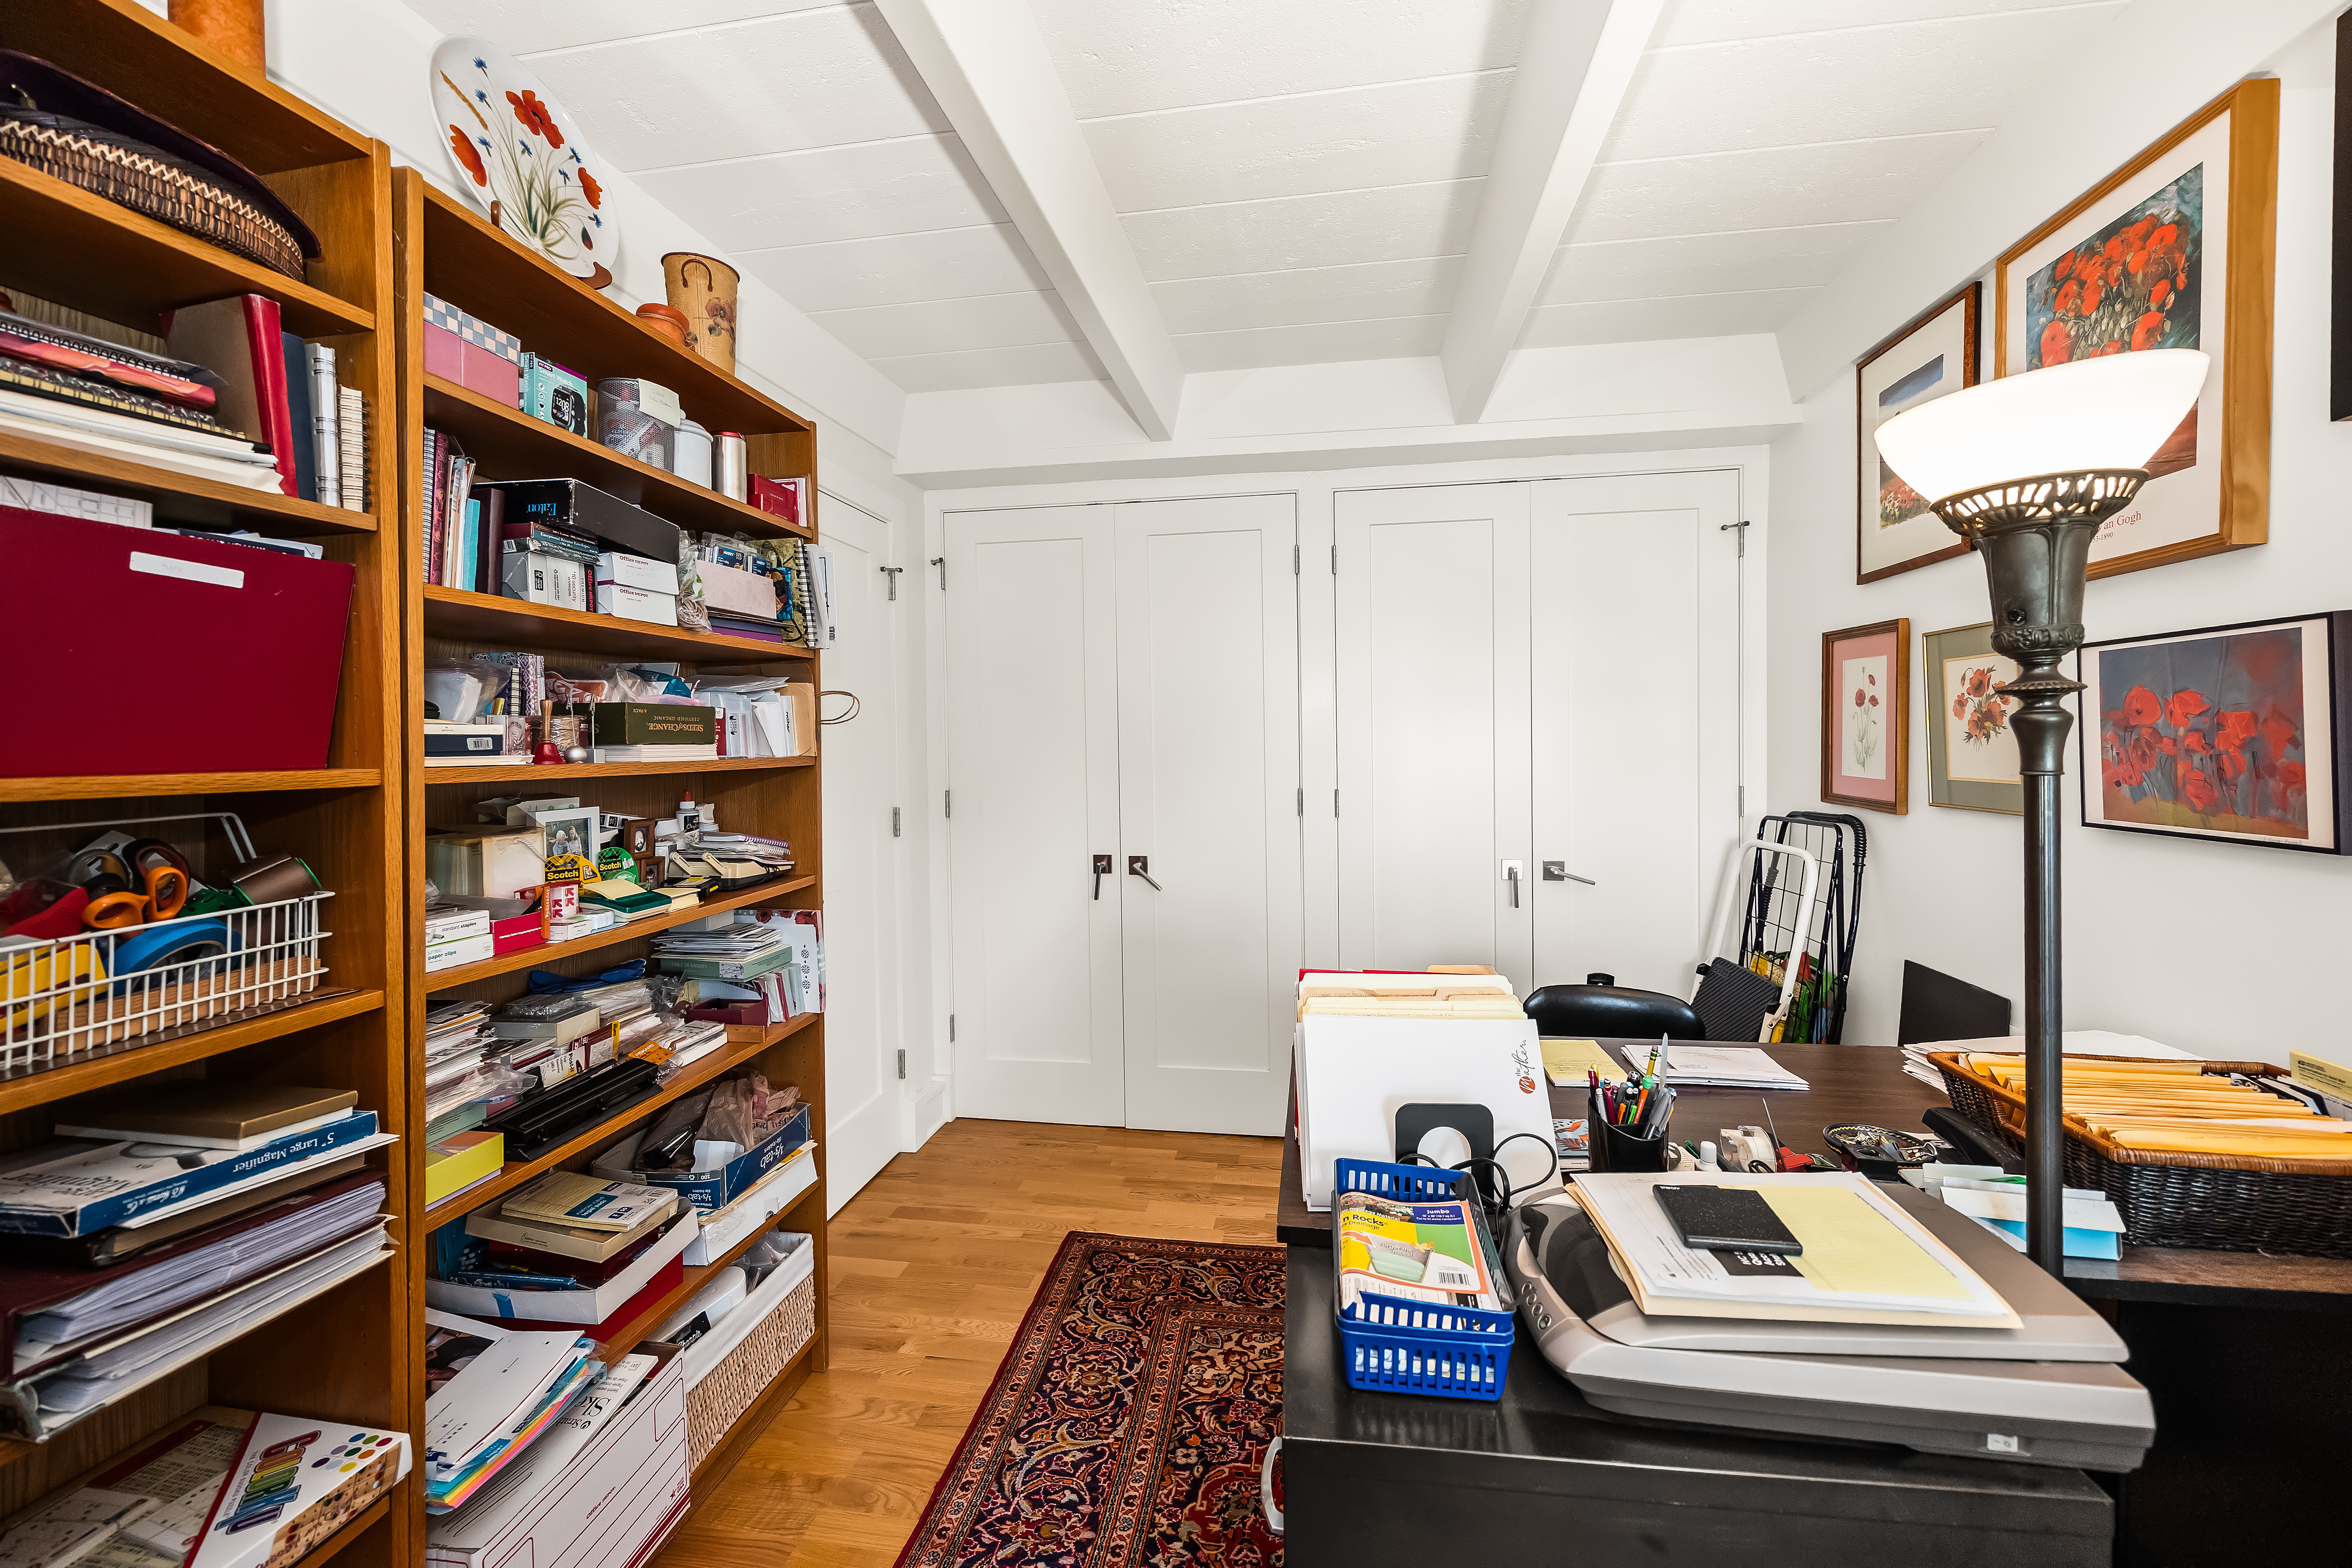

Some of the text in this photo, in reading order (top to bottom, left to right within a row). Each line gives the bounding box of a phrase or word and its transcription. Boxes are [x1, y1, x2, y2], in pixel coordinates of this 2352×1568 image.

[539, 367, 573, 387] Smart Watch
[528, 503, 557, 516] Eaton
[2117, 511, 2142, 526] Gogh
[540, 532, 560, 541] Exceptional
[600, 861, 622, 871] Scotch
[547, 870, 579, 880] Scotch
[634, 1043, 655, 1057] FISKARS
[289, 1138, 318, 1153] Large
[764, 1141, 776, 1153] folders
[233, 1148, 287, 1173] Magnifier
[581, 1200, 607, 1216] legal pads
[1353, 1214, 1384, 1226] Rocks
[1376, 1212, 1400, 1221] Material
[1349, 1221, 1380, 1230] Drainage
[1379, 1242, 1402, 1252] Forget
[214, 1430, 322, 1535] COLORKU
[586, 1501, 602, 1519] Office
